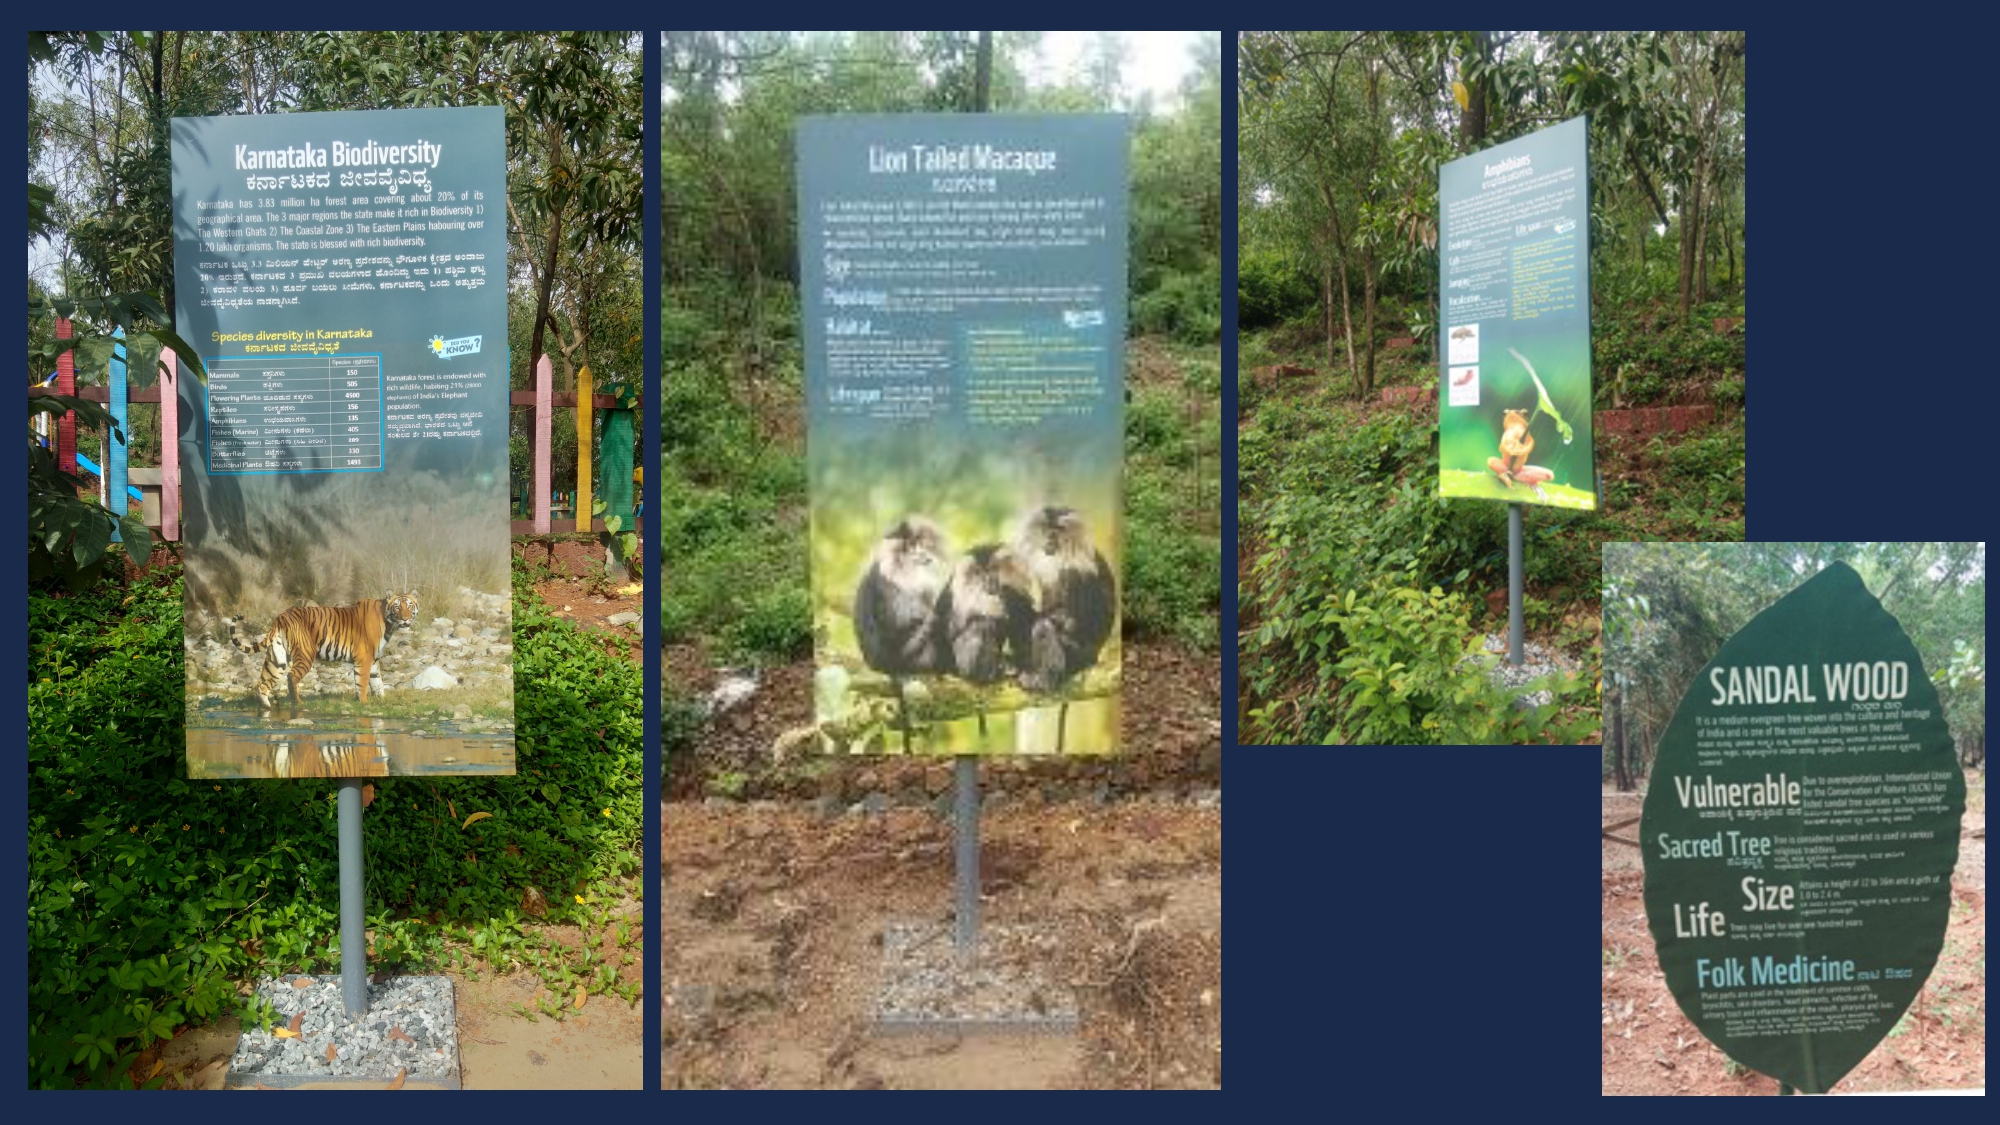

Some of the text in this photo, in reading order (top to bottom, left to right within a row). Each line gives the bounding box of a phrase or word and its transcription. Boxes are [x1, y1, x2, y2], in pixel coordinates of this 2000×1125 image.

[236, 140, 441, 170] Karnataka Biodiversity
[1484, 155, 1531, 178] Amphibians
[247, 168, 432, 194] ಕರ್ನಾಟಕದ ಜೀವವೈವಿಧ್ಯ
[198, 191, 483, 209] Karnataka has 3.83 million ha forest area covering about 20% of its
[198, 214, 242, 225] geographical
[266, 213, 279, 221] The
[282, 212, 286, 221] 3
[289, 212, 310, 222] major
[312, 211, 338, 222] regions
[341, 211, 352, 219] the
[355, 210, 372, 218] state
[376, 209, 395, 218] make
[398, 209, 402, 217] it
[405, 208, 418, 217] rich
[422, 208, 428, 216] in
[431, 206, 473, 216] Biodiversity
[477, 205, 483, 214] 1)
[198, 229, 210, 238] The
[214, 228, 242, 237] Western
[246, 227, 266, 236] Ghats
[270, 227, 277, 236] 2)
[280, 226, 293, 235] The
[296, 226, 323, 235] Coastal
[326, 225, 343, 234] Zone
[346, 225, 354, 234] 3)
[357, 224, 370, 233] The
[373, 223, 400, 232] Eastern
[404, 222, 425, 231] Plains
[429, 221, 465, 231] habouring
[199, 236, 425, 252] 1.20 lakh organisms. The state is blessed with rich biodiversity.
[212, 329, 372, 344] Species diversity in Karnataka
[446, 344, 473, 354] KNOW
[1710, 661, 1908, 706] SANDAL WOOD
[1696, 716, 1702, 725] It
[1704, 717, 1709, 725] is
[1719, 716, 1748, 724] medium
[1751, 716, 1785, 725] evergreen
[1787, 714, 1801, 722] tree
[1829, 713, 1842, 721] into
[1844, 712, 1855, 720] the
[1858, 712, 1883, 720] culture
[1885, 711, 1898, 719] and
[1901, 710, 1930, 719] heritage
[1698, 729, 1704, 737] of
[1707, 729, 1724, 737] India
[1727, 728, 1740, 736] and
[1742, 728, 1748, 736] is
[1766, 727, 1772, 736] of
[1775, 727, 1785, 735] the
[1789, 726, 1806, 735] most
[1807, 725, 1838, 734] valuable
[1840, 725, 1857, 733] trees
[1869, 723, 1880, 732] the
[1675, 773, 1800, 809] Vulnerable
[1658, 831, 1771, 858] Sacred Tree
[1742, 876, 1794, 911] Size
[1673, 902, 1726, 938] Life
[1697, 958, 1745, 988] Folk
[1751, 955, 1854, 985] Medicine
